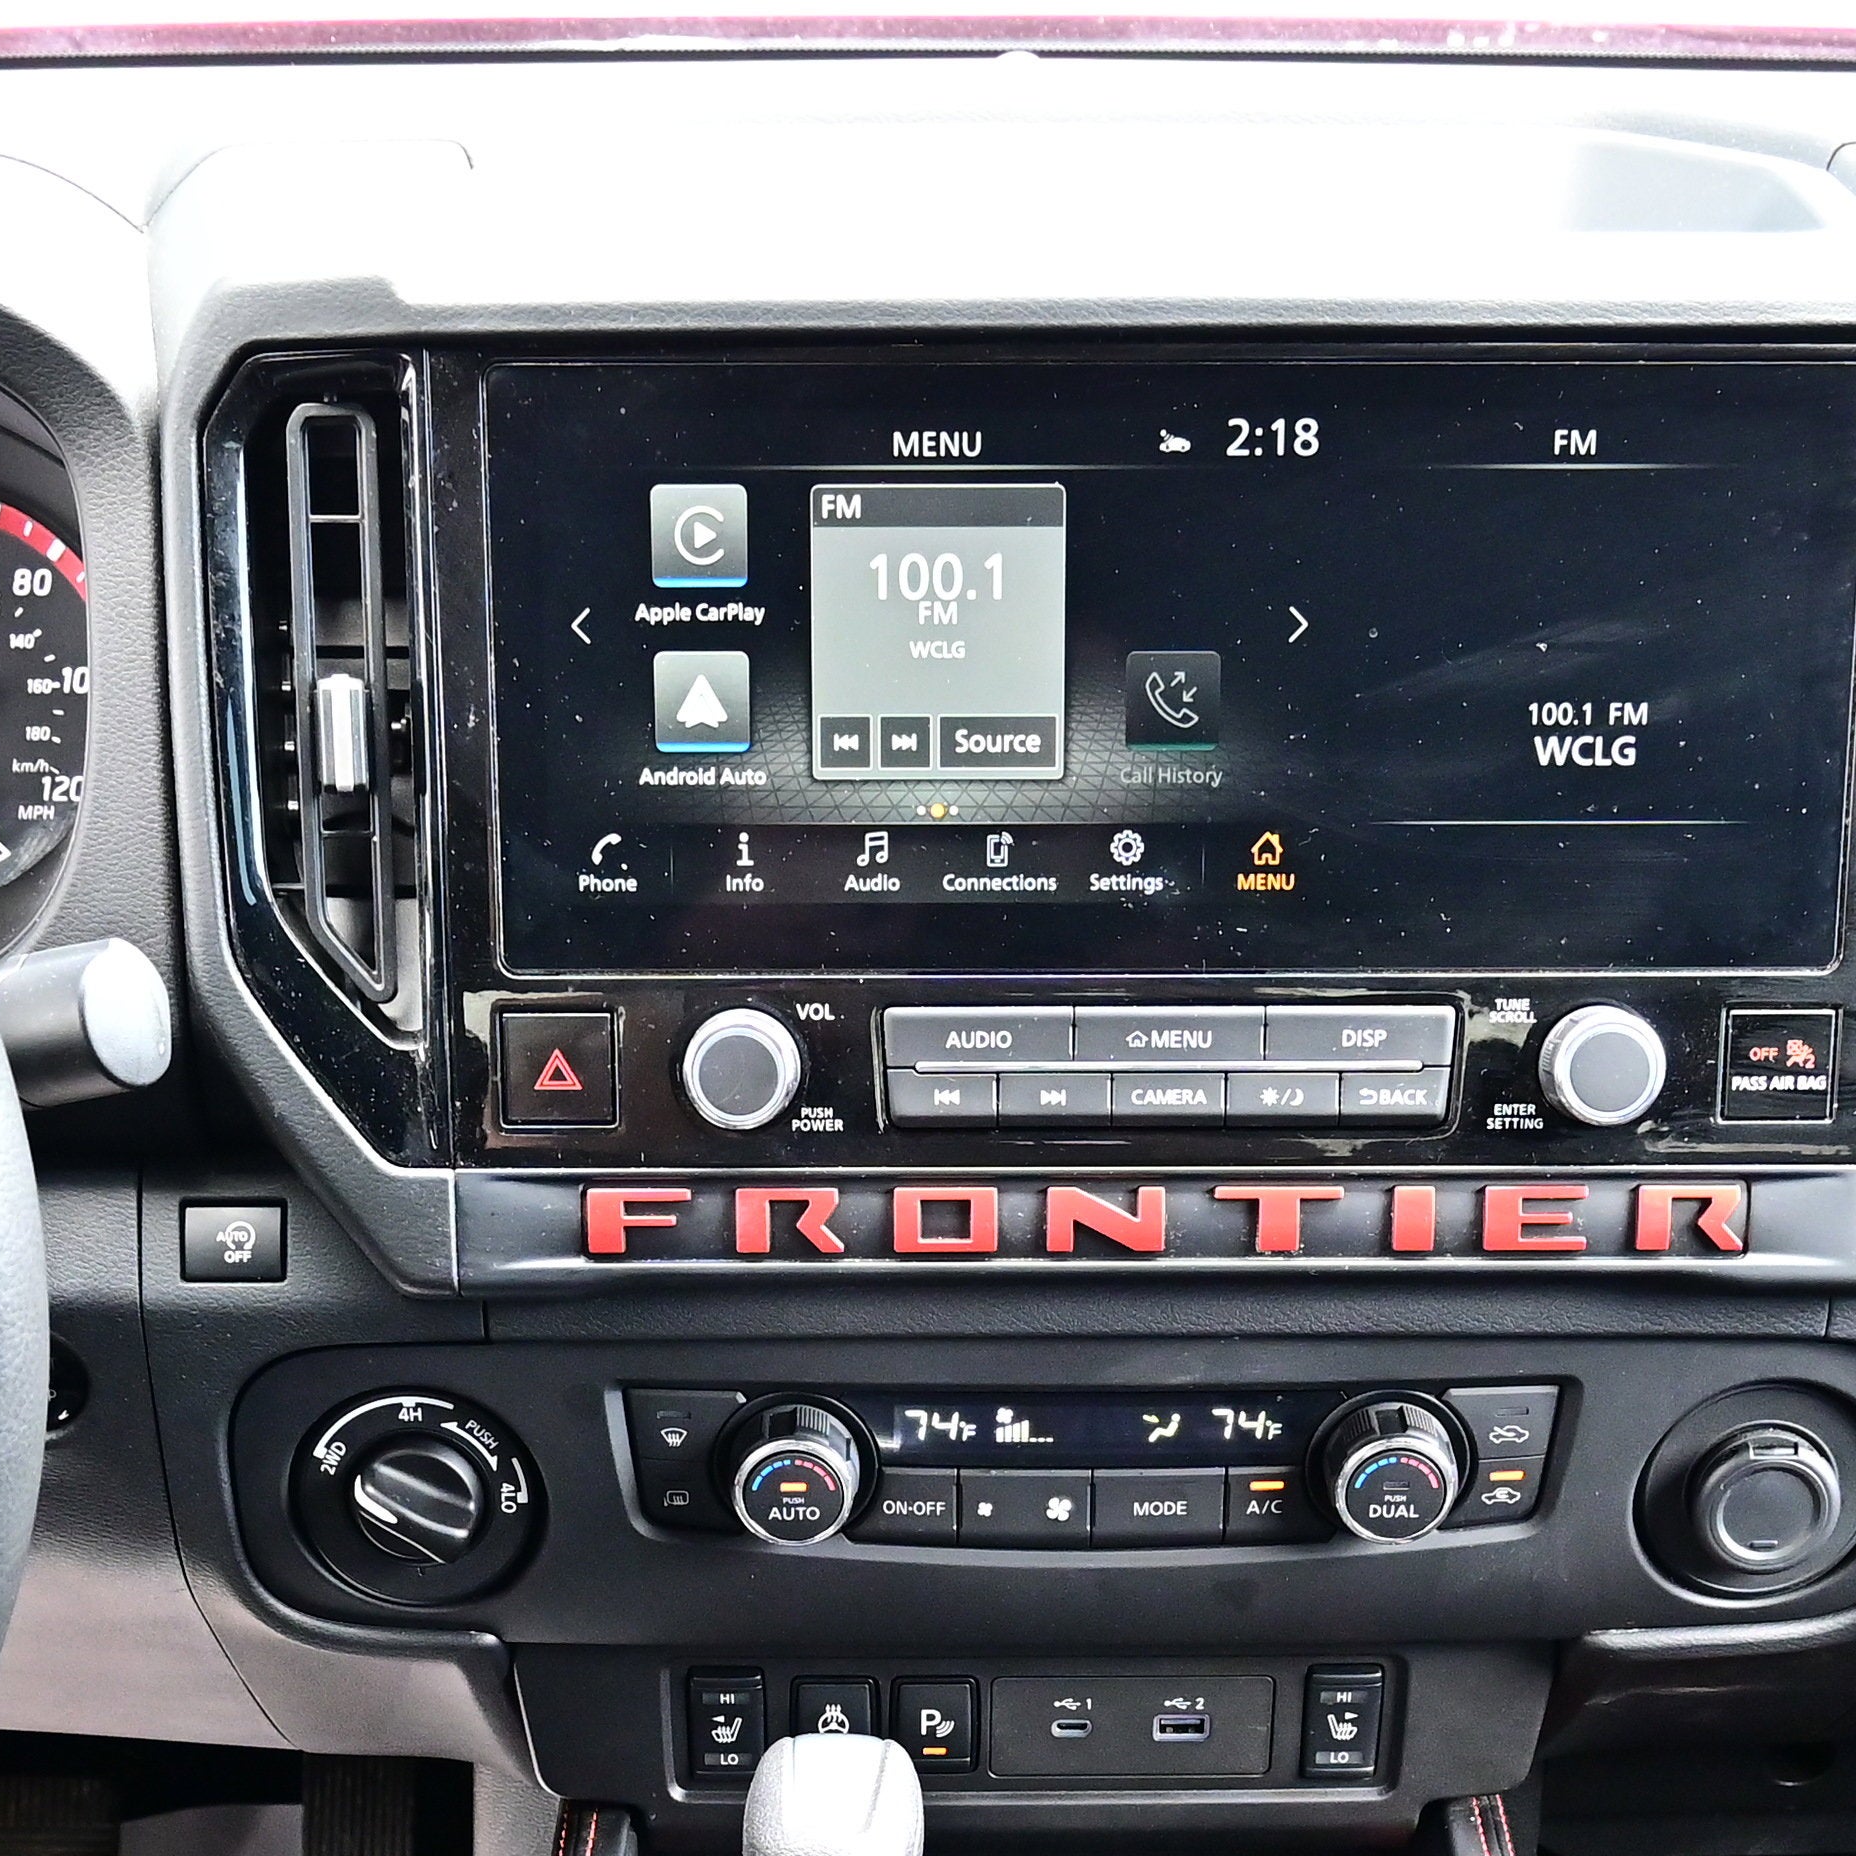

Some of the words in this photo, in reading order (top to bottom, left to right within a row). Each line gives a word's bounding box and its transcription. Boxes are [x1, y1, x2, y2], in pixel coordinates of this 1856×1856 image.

[892, 431, 983, 457] MENU
[1225, 417, 1320, 458] 2:18
[1553, 430, 1598, 457] FM
[821, 494, 862, 520] FM
[12, 568, 52, 597] 80
[869, 553, 1004, 602] 100.1
[634, 602, 691, 625] Apple
[695, 602, 765, 625] CarPlay
[917, 600, 958, 626] FM
[10, 633, 35, 649] 140
[909, 640, 966, 660] WCLG
[27, 679, 52, 694] 160
[62, 666, 89, 695] 10
[1527, 702, 1592, 727] 100.1
[1607, 702, 1648, 727] FM
[25, 726, 50, 741] 180
[954, 728, 1041, 754] Source
[1533, 736, 1637, 768] WCLG
[12, 758, 50, 773] km/h
[639, 766, 716, 786] Android
[719, 767, 767, 786] Auto
[1120, 767, 1154, 785] Call
[1157, 767, 1224, 790] History
[18, 806, 55, 820] MPH
[578, 875, 638, 894] Phone
[725, 875, 764, 894] Info
[844, 875, 901, 894] Audio
[942, 875, 1058, 894] Connections
[1089, 875, 1165, 898] Settings
[1237, 874, 1295, 892] MENU
[795, 1003, 836, 1021] VOL
[1494, 999, 1531, 1013] TUNE
[1489, 1010, 1537, 1025] SCROLL
[945, 1030, 1013, 1050] AUDIO
[1150, 1029, 1213, 1049] MENU
[1342, 1028, 1388, 1049] DISP
[1749, 1046, 1779, 1062] OFF
[1731, 1076, 1768, 1091] PASS
[1771, 1076, 1793, 1090] AIR
[1796, 1075, 1827, 1090] BAG
[1130, 1088, 1208, 1107] CAMERA
[1377, 1086, 1429, 1107] BACK
[800, 1107, 834, 1120] PUSH
[1493, 1104, 1536, 1118] ENTER
[791, 1118, 844, 1133] POWER
[1486, 1116, 1544, 1131] SETTING
[587, 1184, 1744, 1255] FRONTIER
[216, 1231, 248, 1243] AUTO
[224, 1251, 252, 1264] OFF
[398, 1408, 423, 1423] 4H
[464, 1419, 499, 1451] PUSH
[320, 1441, 347, 1477] 2WD
[499, 1482, 517, 1514] 4LO
[1246, 1499, 1283, 1515] A/C
[768, 1507, 820, 1521] AUTO
[1132, 1501, 1188, 1517] MODE
[1368, 1504, 1420, 1519] DUAL
[720, 1693, 735, 1704] HI
[1195, 1697, 1205, 1710] 2
[1336, 1691, 1352, 1703] HI
[720, 1753, 738, 1766] LO
[1330, 1751, 1349, 1764] LO
